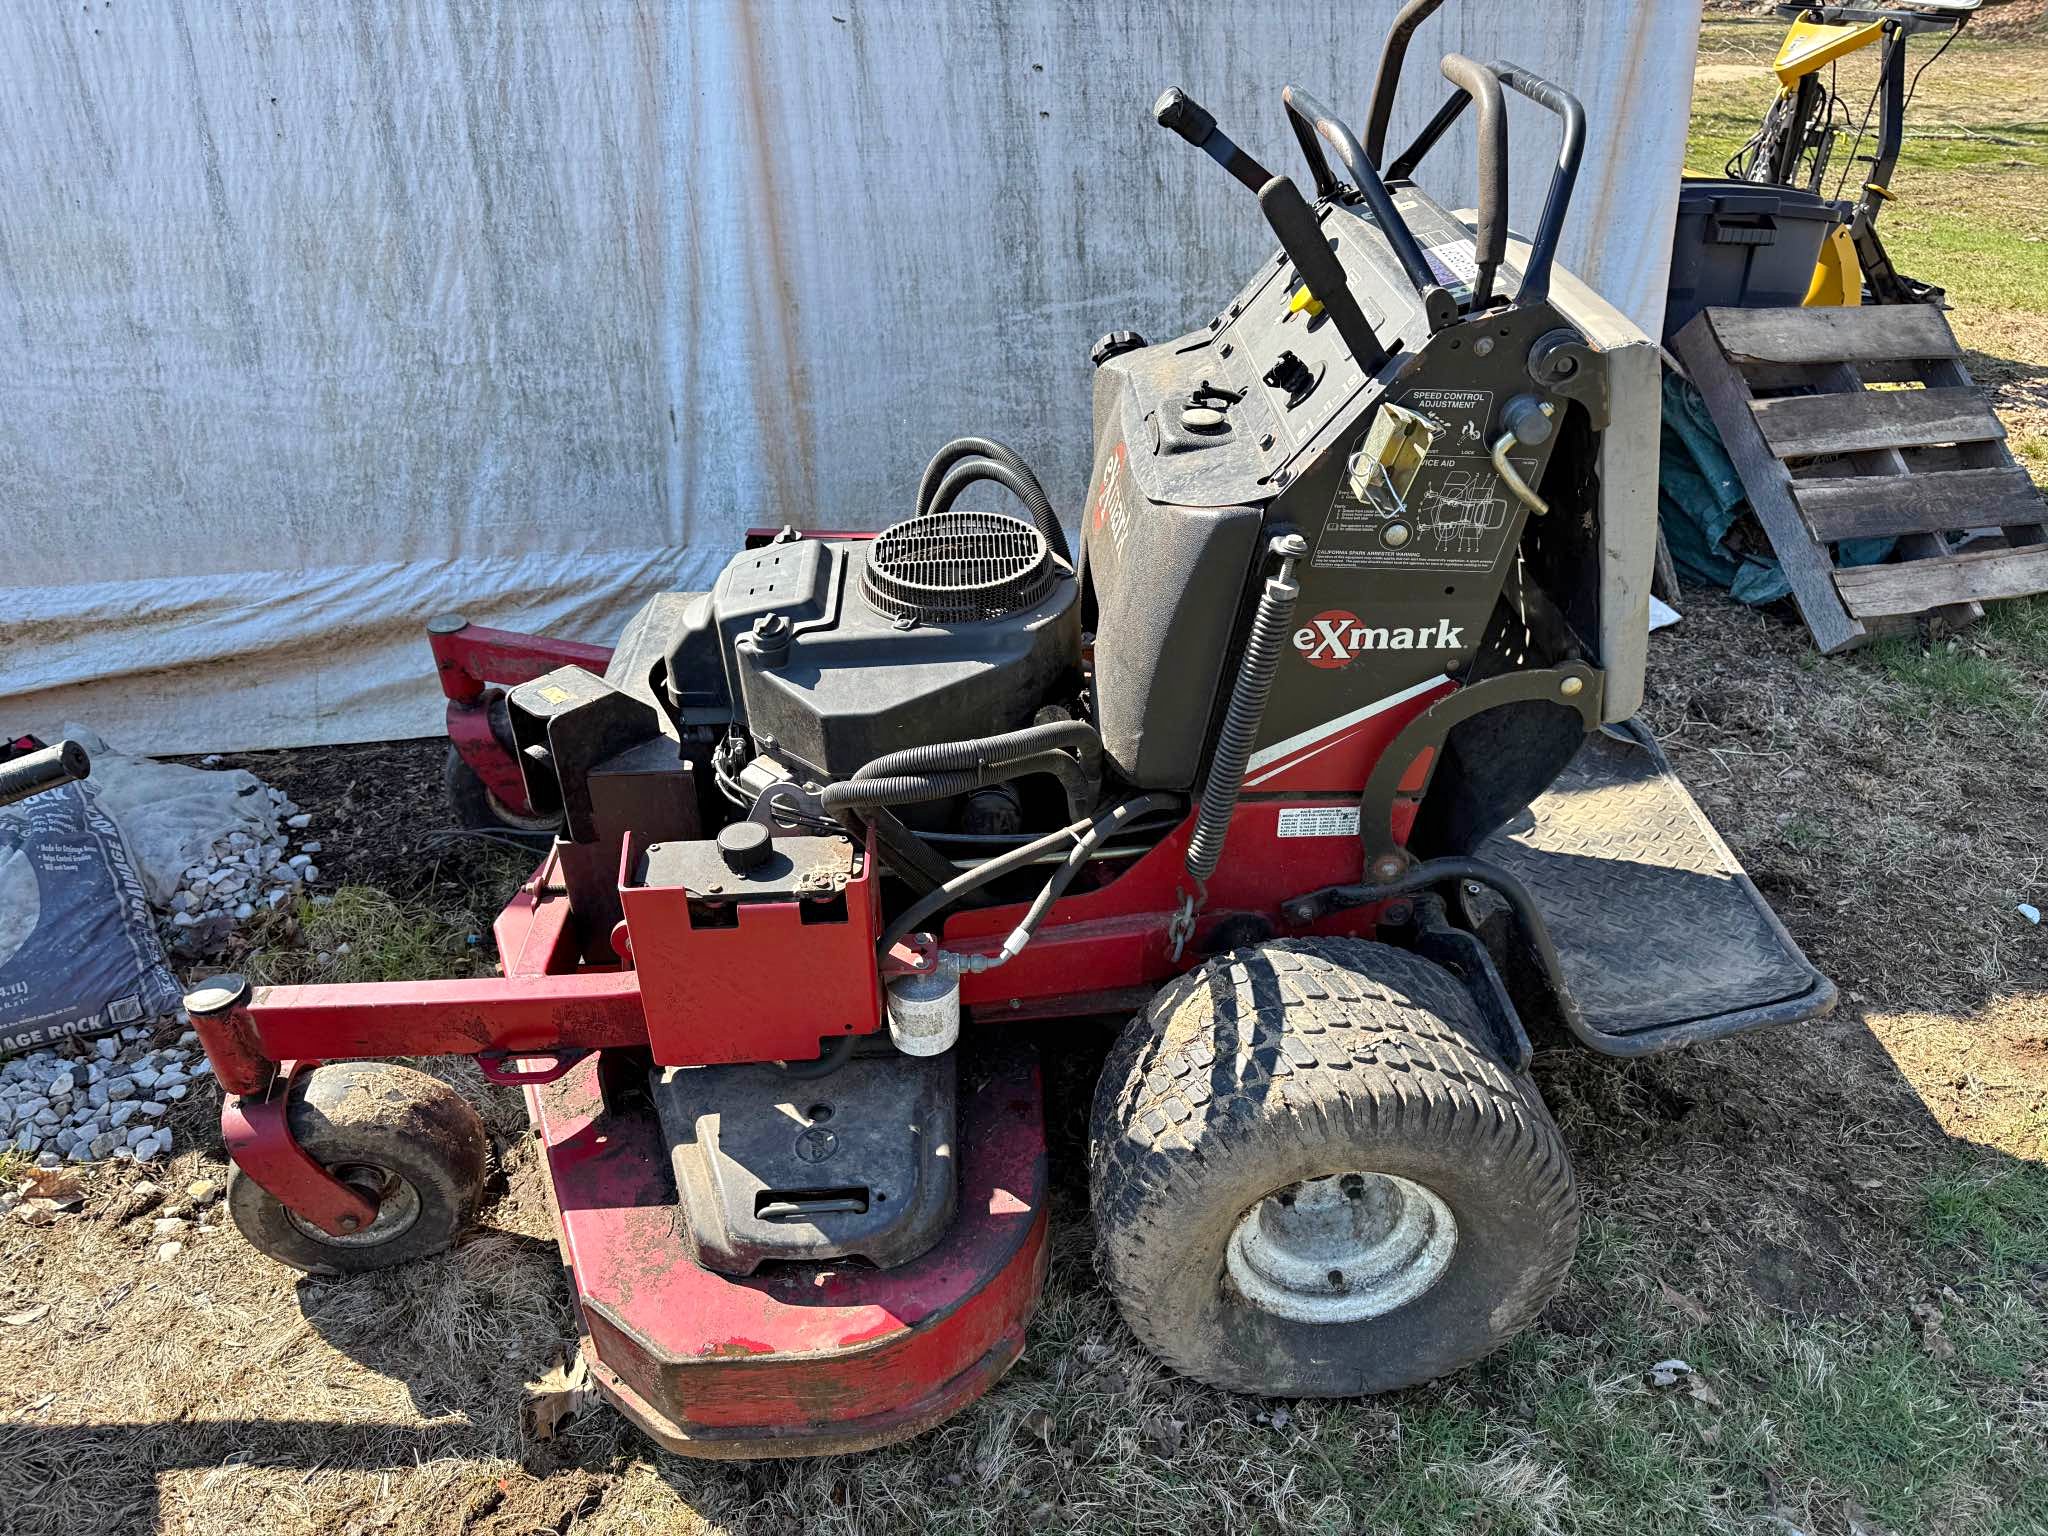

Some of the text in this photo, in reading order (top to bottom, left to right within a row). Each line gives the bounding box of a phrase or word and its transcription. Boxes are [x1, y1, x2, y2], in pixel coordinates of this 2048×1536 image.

[1413, 391, 1485, 401] SPEED CONTROL
[1418, 400, 1476, 409] ADJUSTMENT
[1292, 618, 1465, 659] eXmark
[0, 1029, 44, 1053] AGE
[47, 1014, 103, 1040] ROCK
